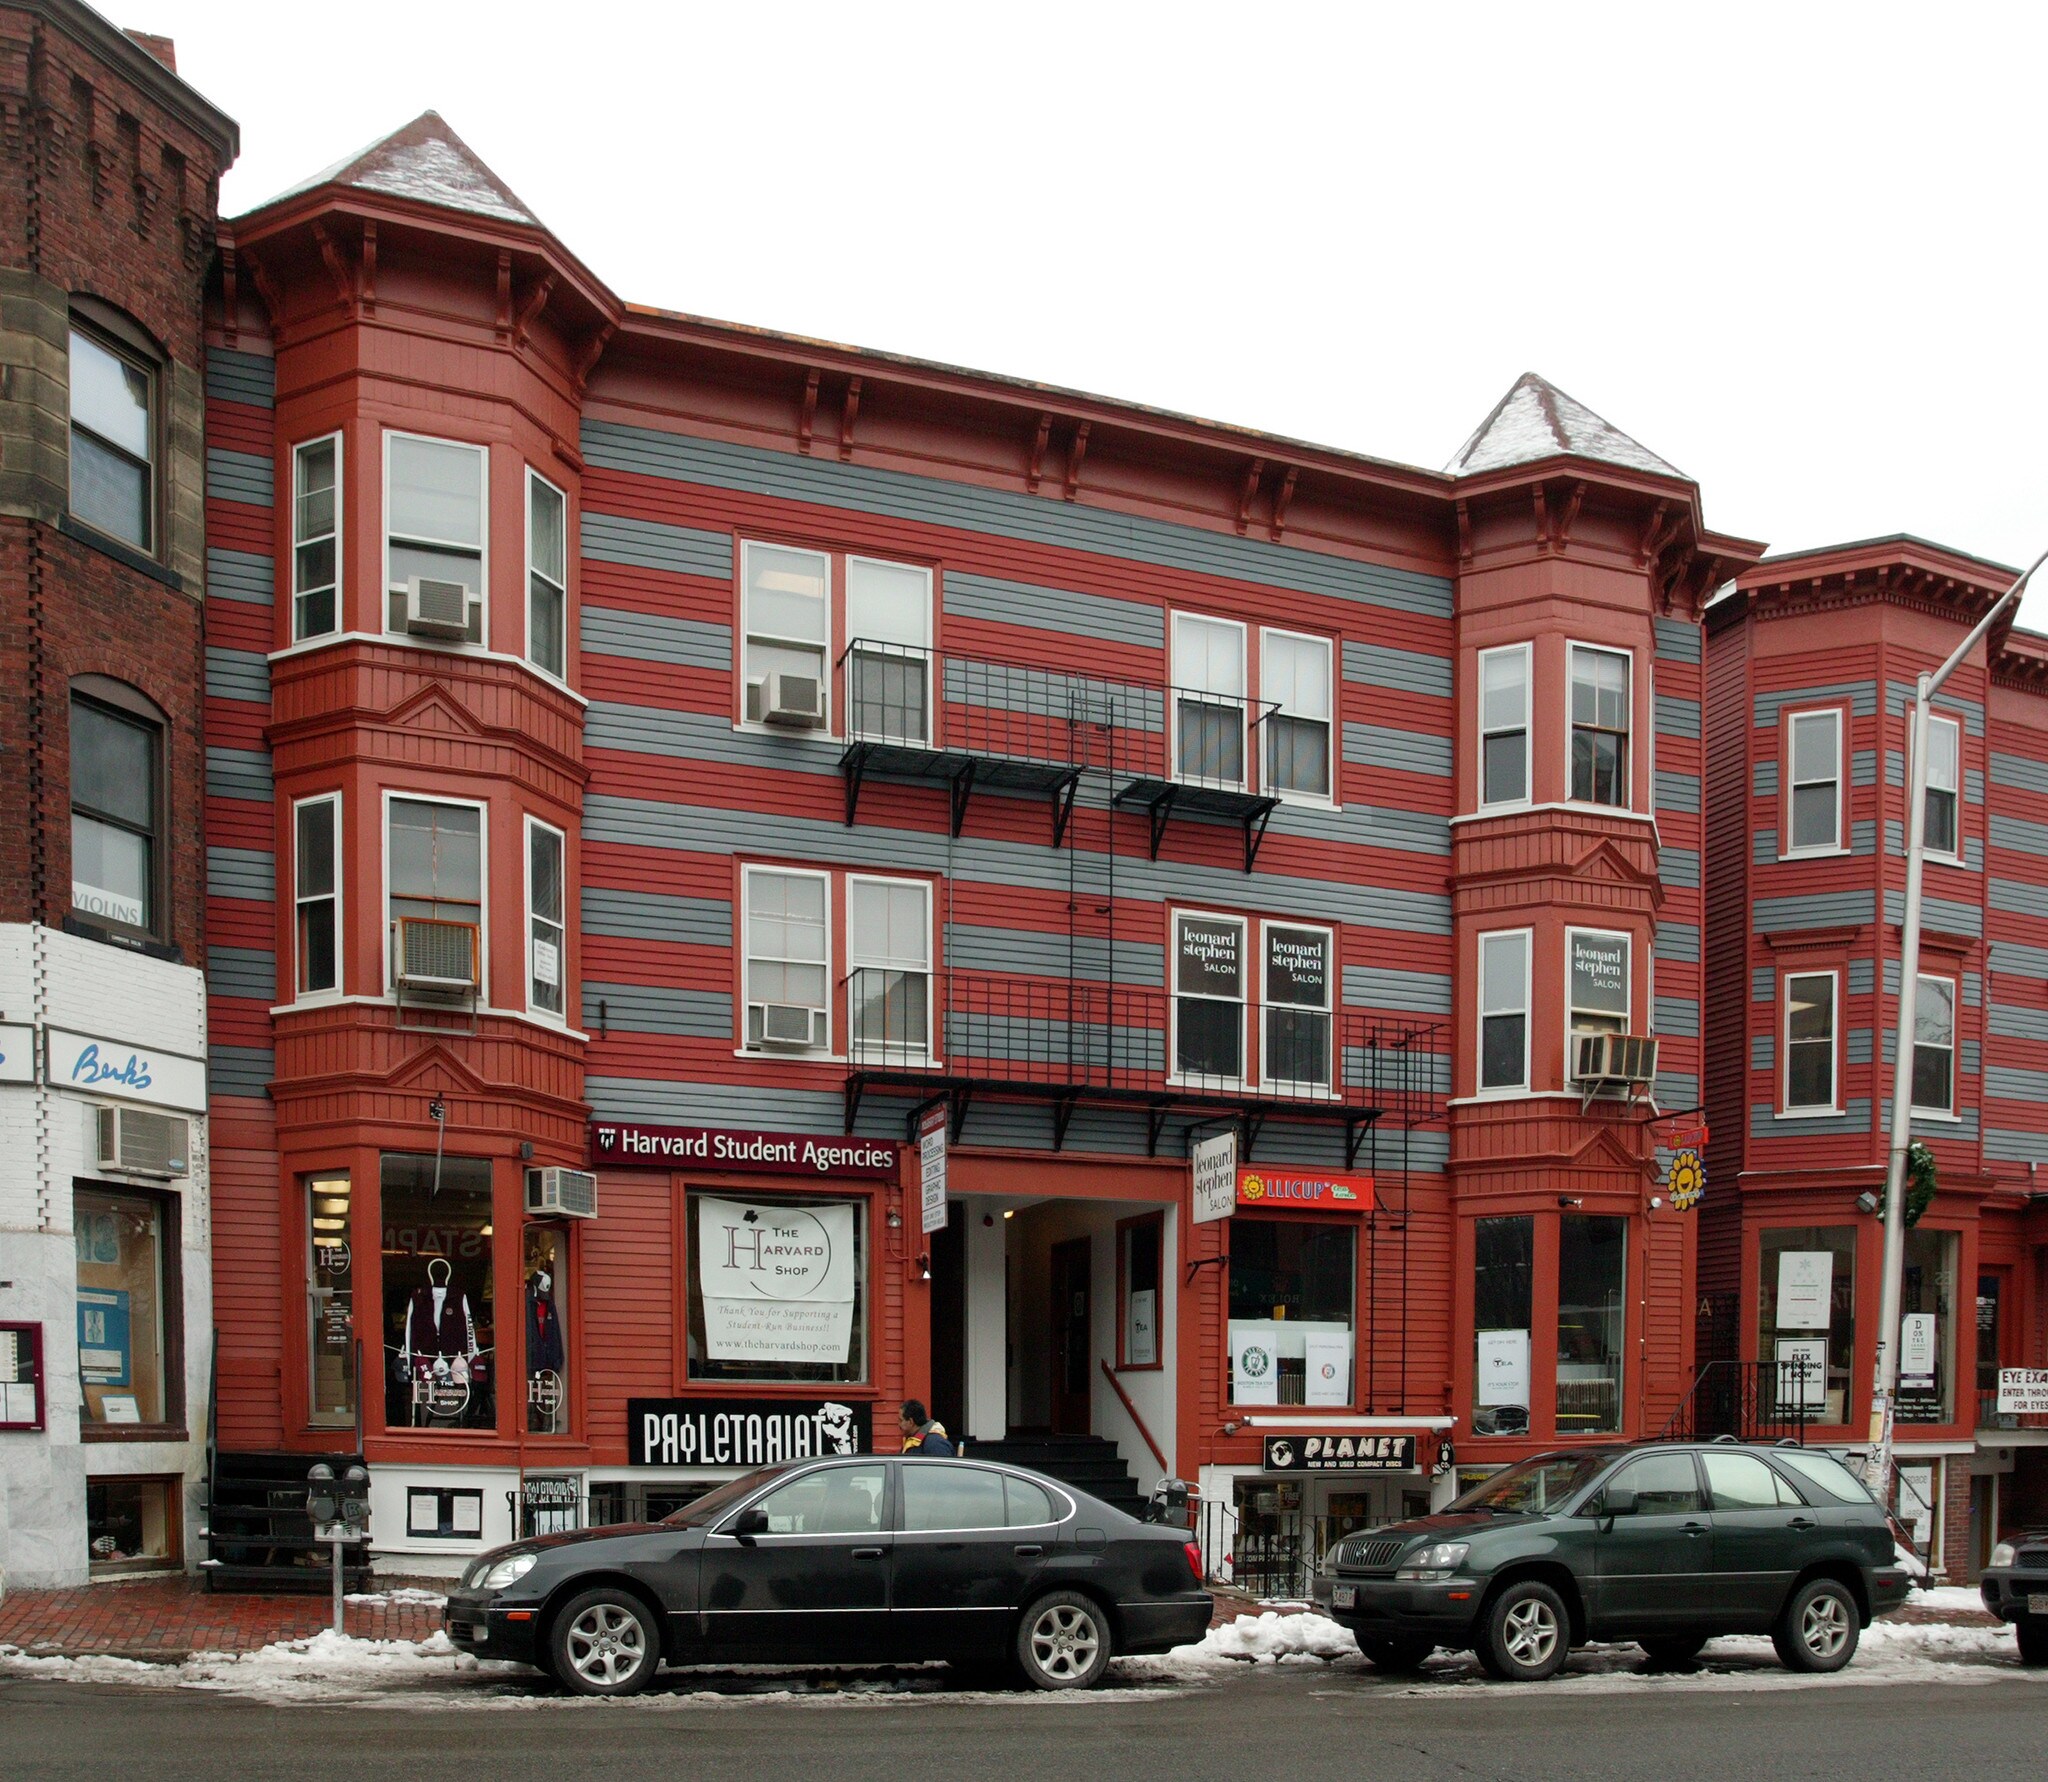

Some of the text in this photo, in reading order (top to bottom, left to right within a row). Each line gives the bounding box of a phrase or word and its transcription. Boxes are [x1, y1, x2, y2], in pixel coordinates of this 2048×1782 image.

[72, 890, 138, 924] VIOLINS
[1184, 926, 1236, 947] leonard
[1183, 942, 1236, 962] stephen
[1272, 938, 1322, 958] leonard
[1575, 943, 1621, 964] leonard
[1204, 962, 1236, 974] SALON
[1271, 954, 1322, 972] stephen
[1575, 959, 1620, 977] stephen
[1292, 973, 1322, 984] SALON
[1593, 978, 1621, 990] SALON
[622, 1129, 894, 1171] Harvard Student Agencies
[1195, 1142, 1233, 1174] leonard
[1195, 1169, 1233, 1199] stephen
[1210, 1196, 1233, 1212] SALON
[772, 1227, 799, 1238] THE
[775, 1265, 809, 1276] SHOP
[717, 1305, 745, 1317] Thank
[750, 1307, 765, 1316] You
[767, 1308, 781, 1319] for
[782, 1308, 831, 1320] Supporting
[716, 1339, 841, 1351] www.theharvardshop.com
[1494, 1359, 1513, 1367] TEA
[1780, 1362, 1822, 1370] SPENDING
[2002, 1371, 2048, 1383] EYE EXA
[2002, 1388, 2025, 1397] ENTER
[2013, 1400, 2028, 1409] FOR
[1304, 1437, 1407, 1459] PLANET
[1307, 1460, 1322, 1468] NEW
